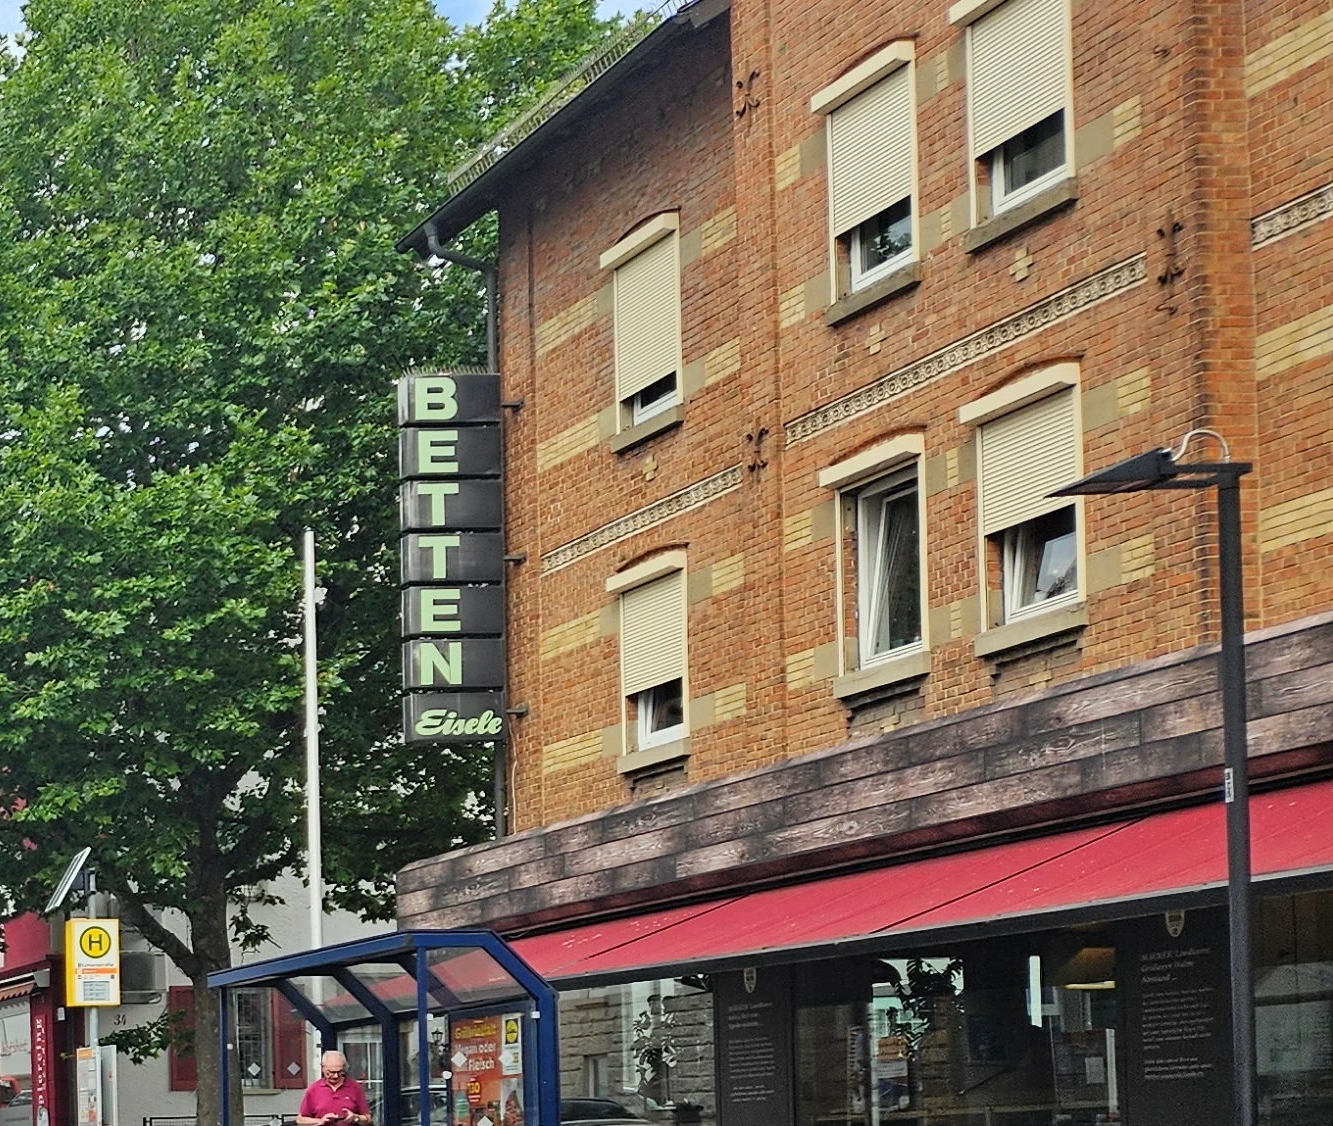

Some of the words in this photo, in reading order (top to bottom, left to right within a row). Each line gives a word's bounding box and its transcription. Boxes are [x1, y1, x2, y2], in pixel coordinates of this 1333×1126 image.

[414, 376, 462, 686] BETTEN
[414, 709, 503, 737] Eisele
[88, 933, 103, 951] H
